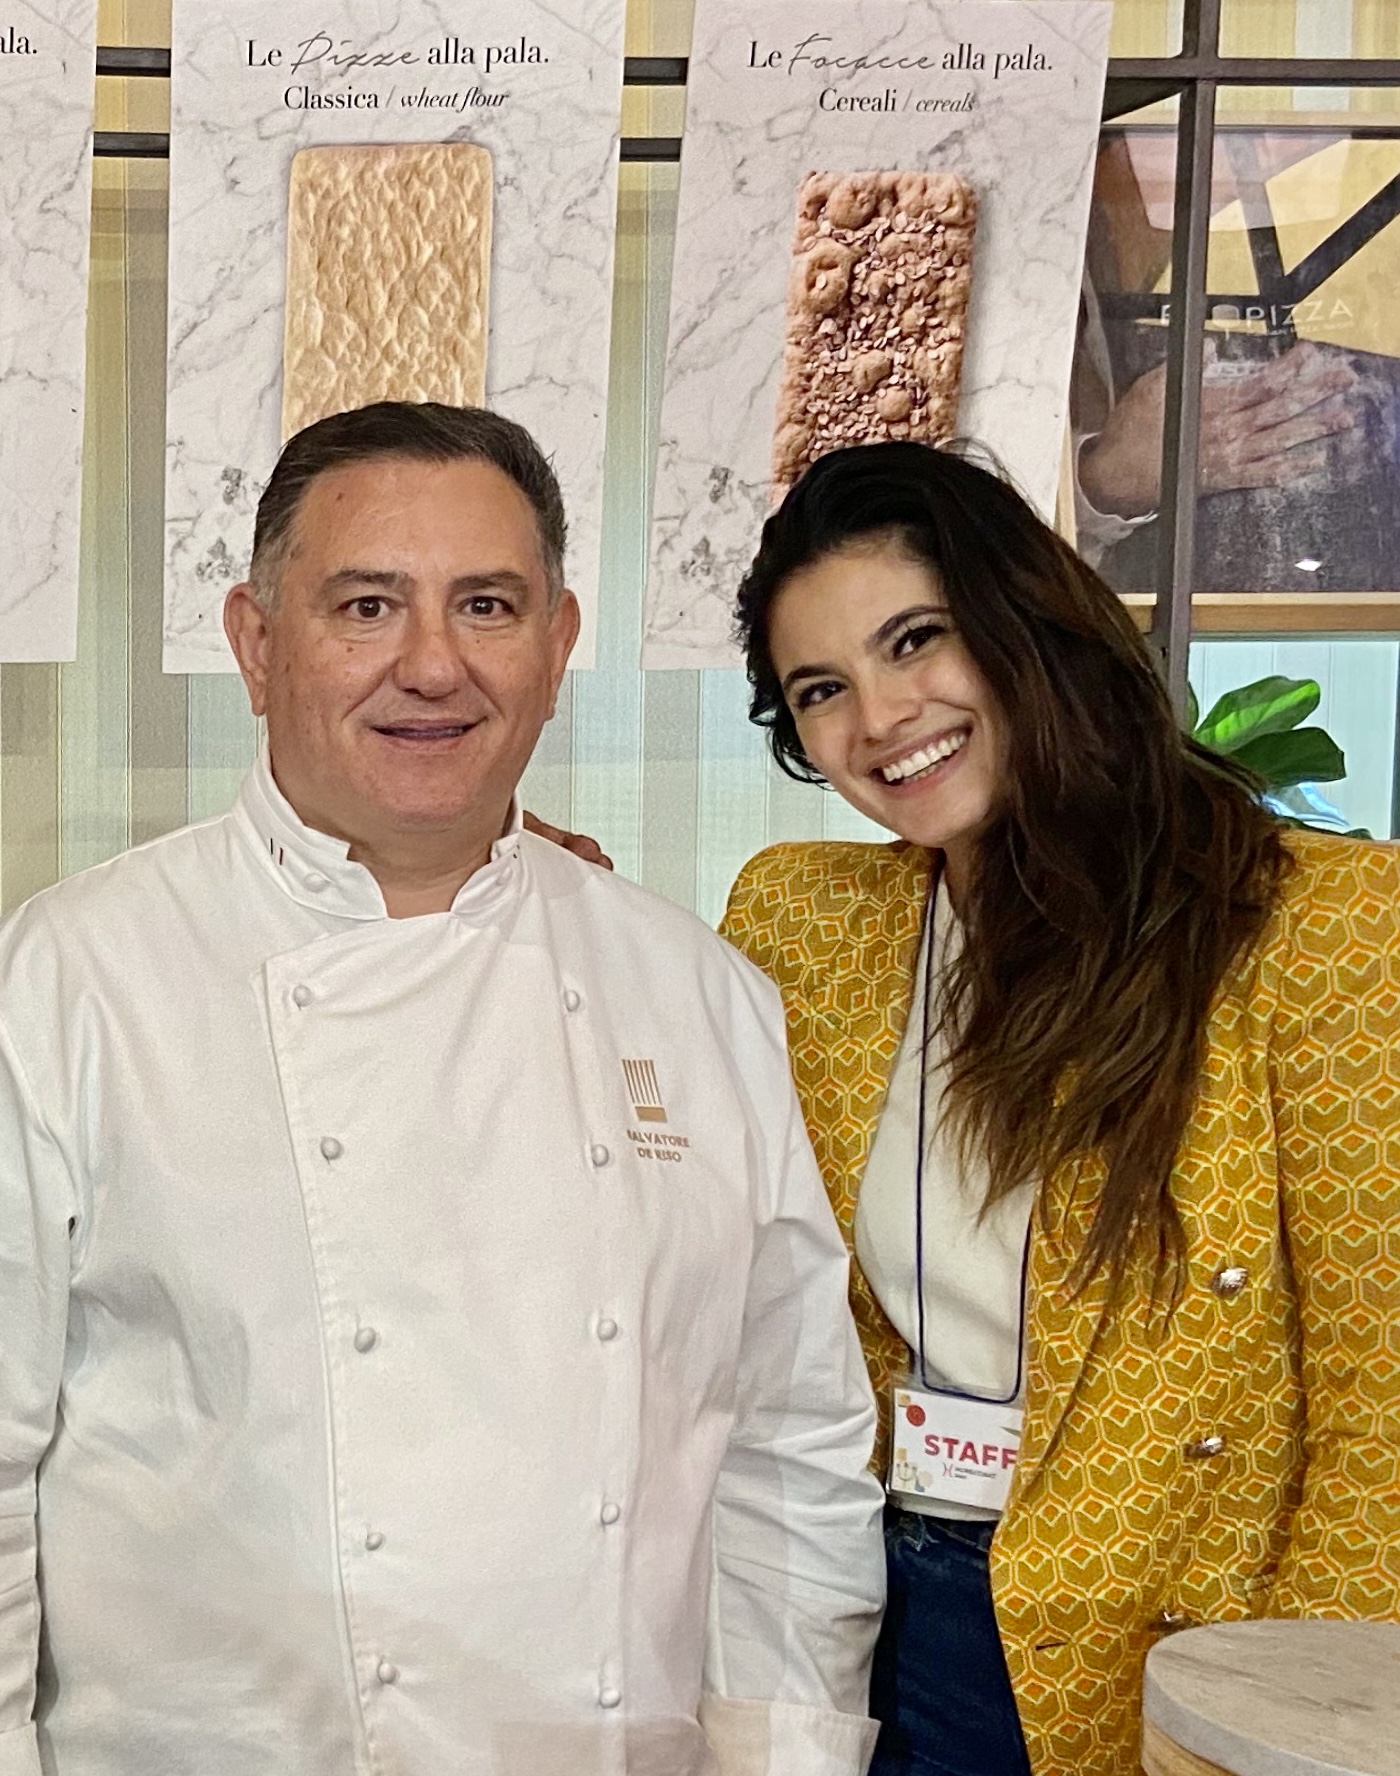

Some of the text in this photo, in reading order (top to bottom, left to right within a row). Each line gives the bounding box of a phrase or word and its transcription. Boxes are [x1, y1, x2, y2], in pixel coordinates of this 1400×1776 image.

[246, 30, 550, 75] Le Pizze alla pala.
[749, 33, 1053, 79] Le Focacce alla pala.
[284, 86, 380, 110] Classica
[400, 87, 458, 109] wheat
[458, 86, 512, 113] flour
[818, 87, 897, 112] Cereali
[915, 92, 977, 113] cereals
[636, 1147, 654, 1160] DE
[924, 1434, 1017, 1470] STAFF
